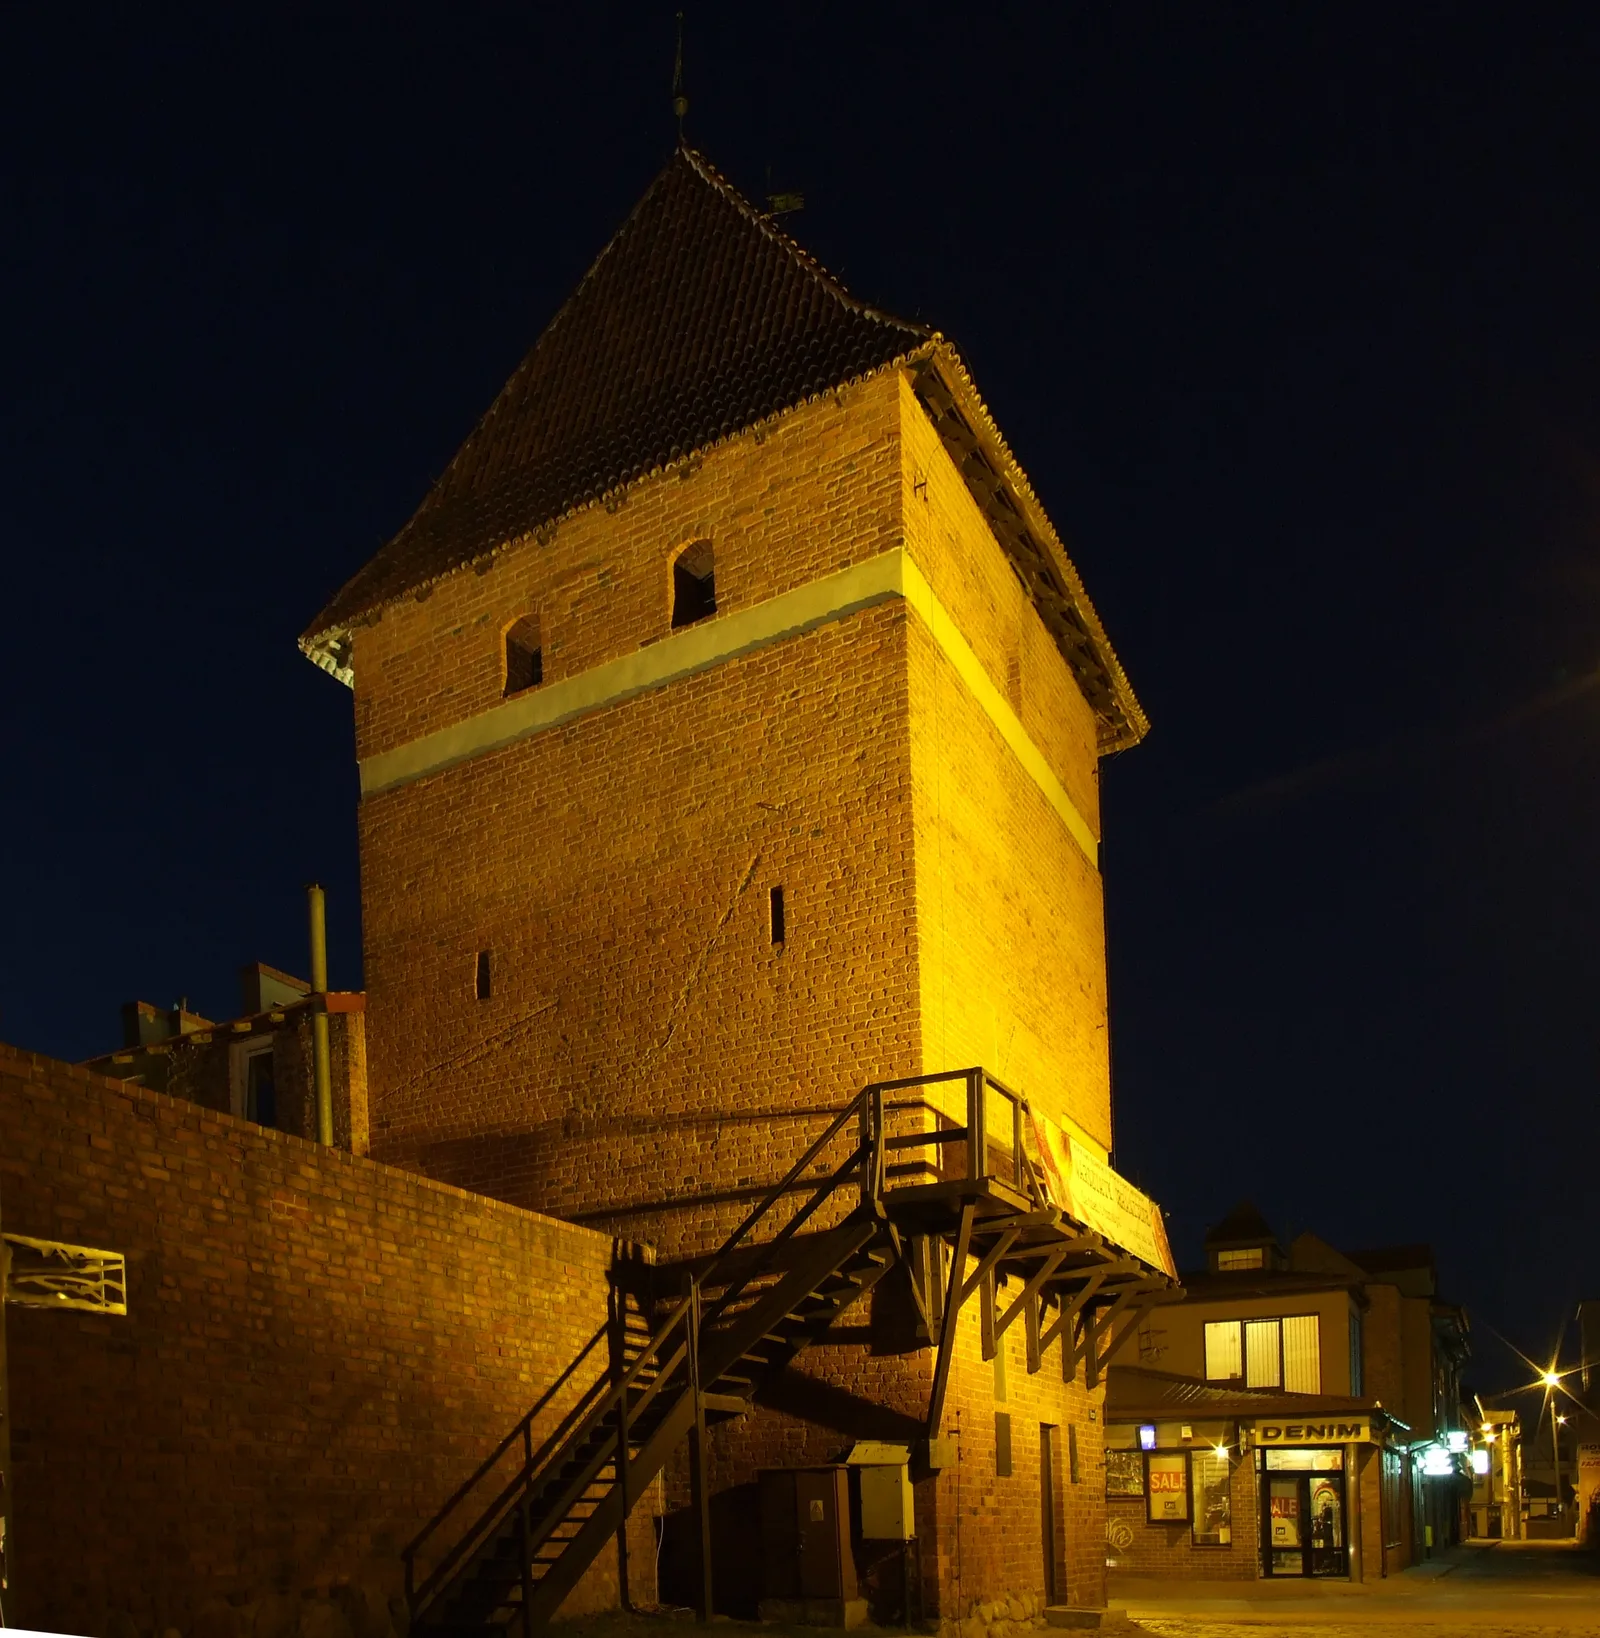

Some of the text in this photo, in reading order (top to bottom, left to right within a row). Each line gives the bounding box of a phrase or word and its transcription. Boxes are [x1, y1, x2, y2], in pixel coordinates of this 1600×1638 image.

[1262, 1423, 1361, 1440] DENIM
[1151, 1473, 1187, 1489] SALE
[1271, 1498, 1297, 1515] ALE
